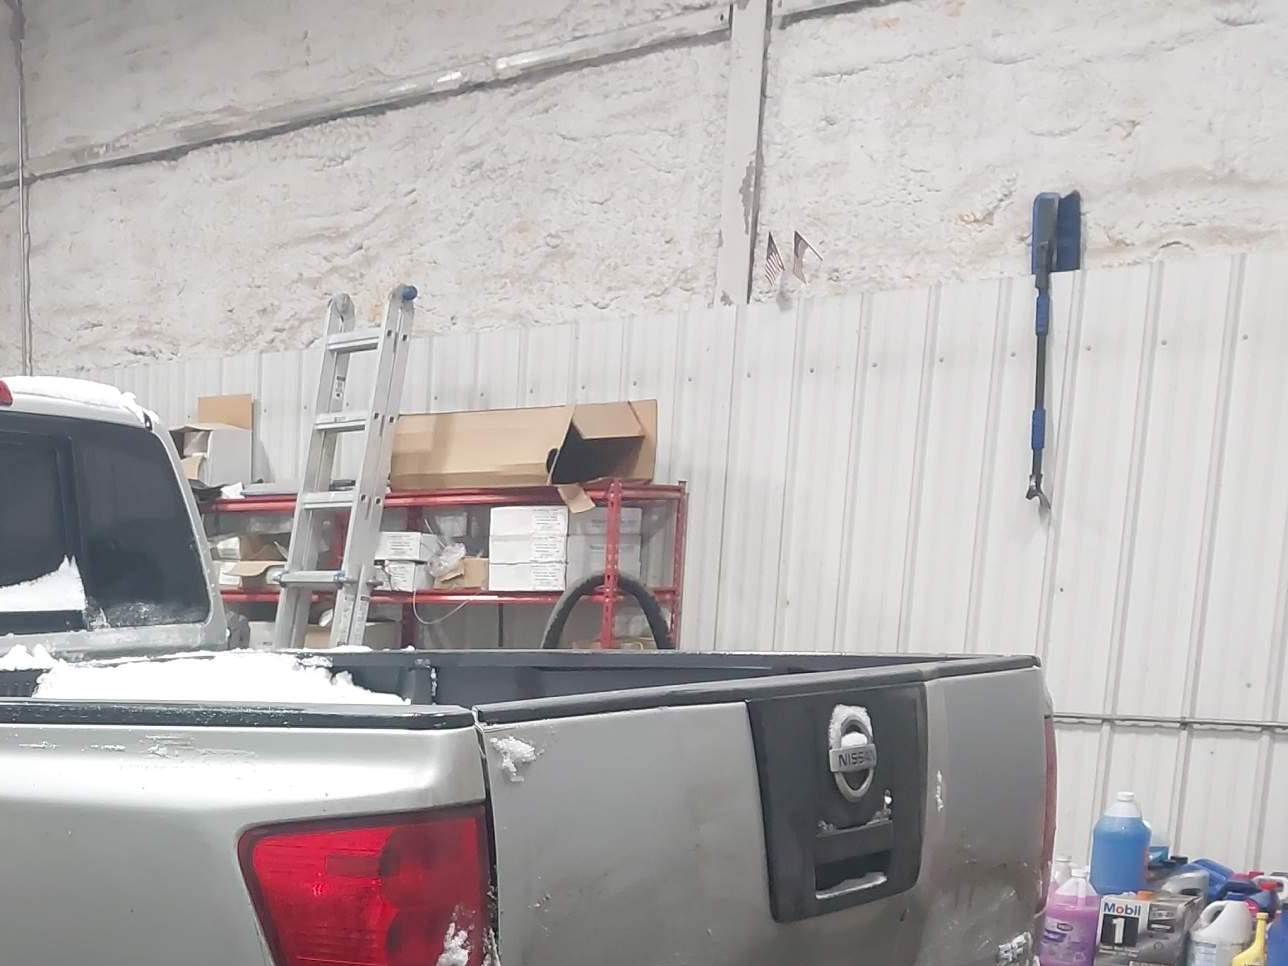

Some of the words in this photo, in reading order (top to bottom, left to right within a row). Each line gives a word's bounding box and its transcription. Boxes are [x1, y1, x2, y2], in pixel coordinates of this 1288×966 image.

[838, 750, 873, 767] NISS
[1103, 902, 1141, 917] Mobil
[1112, 917, 1126, 944] 1
